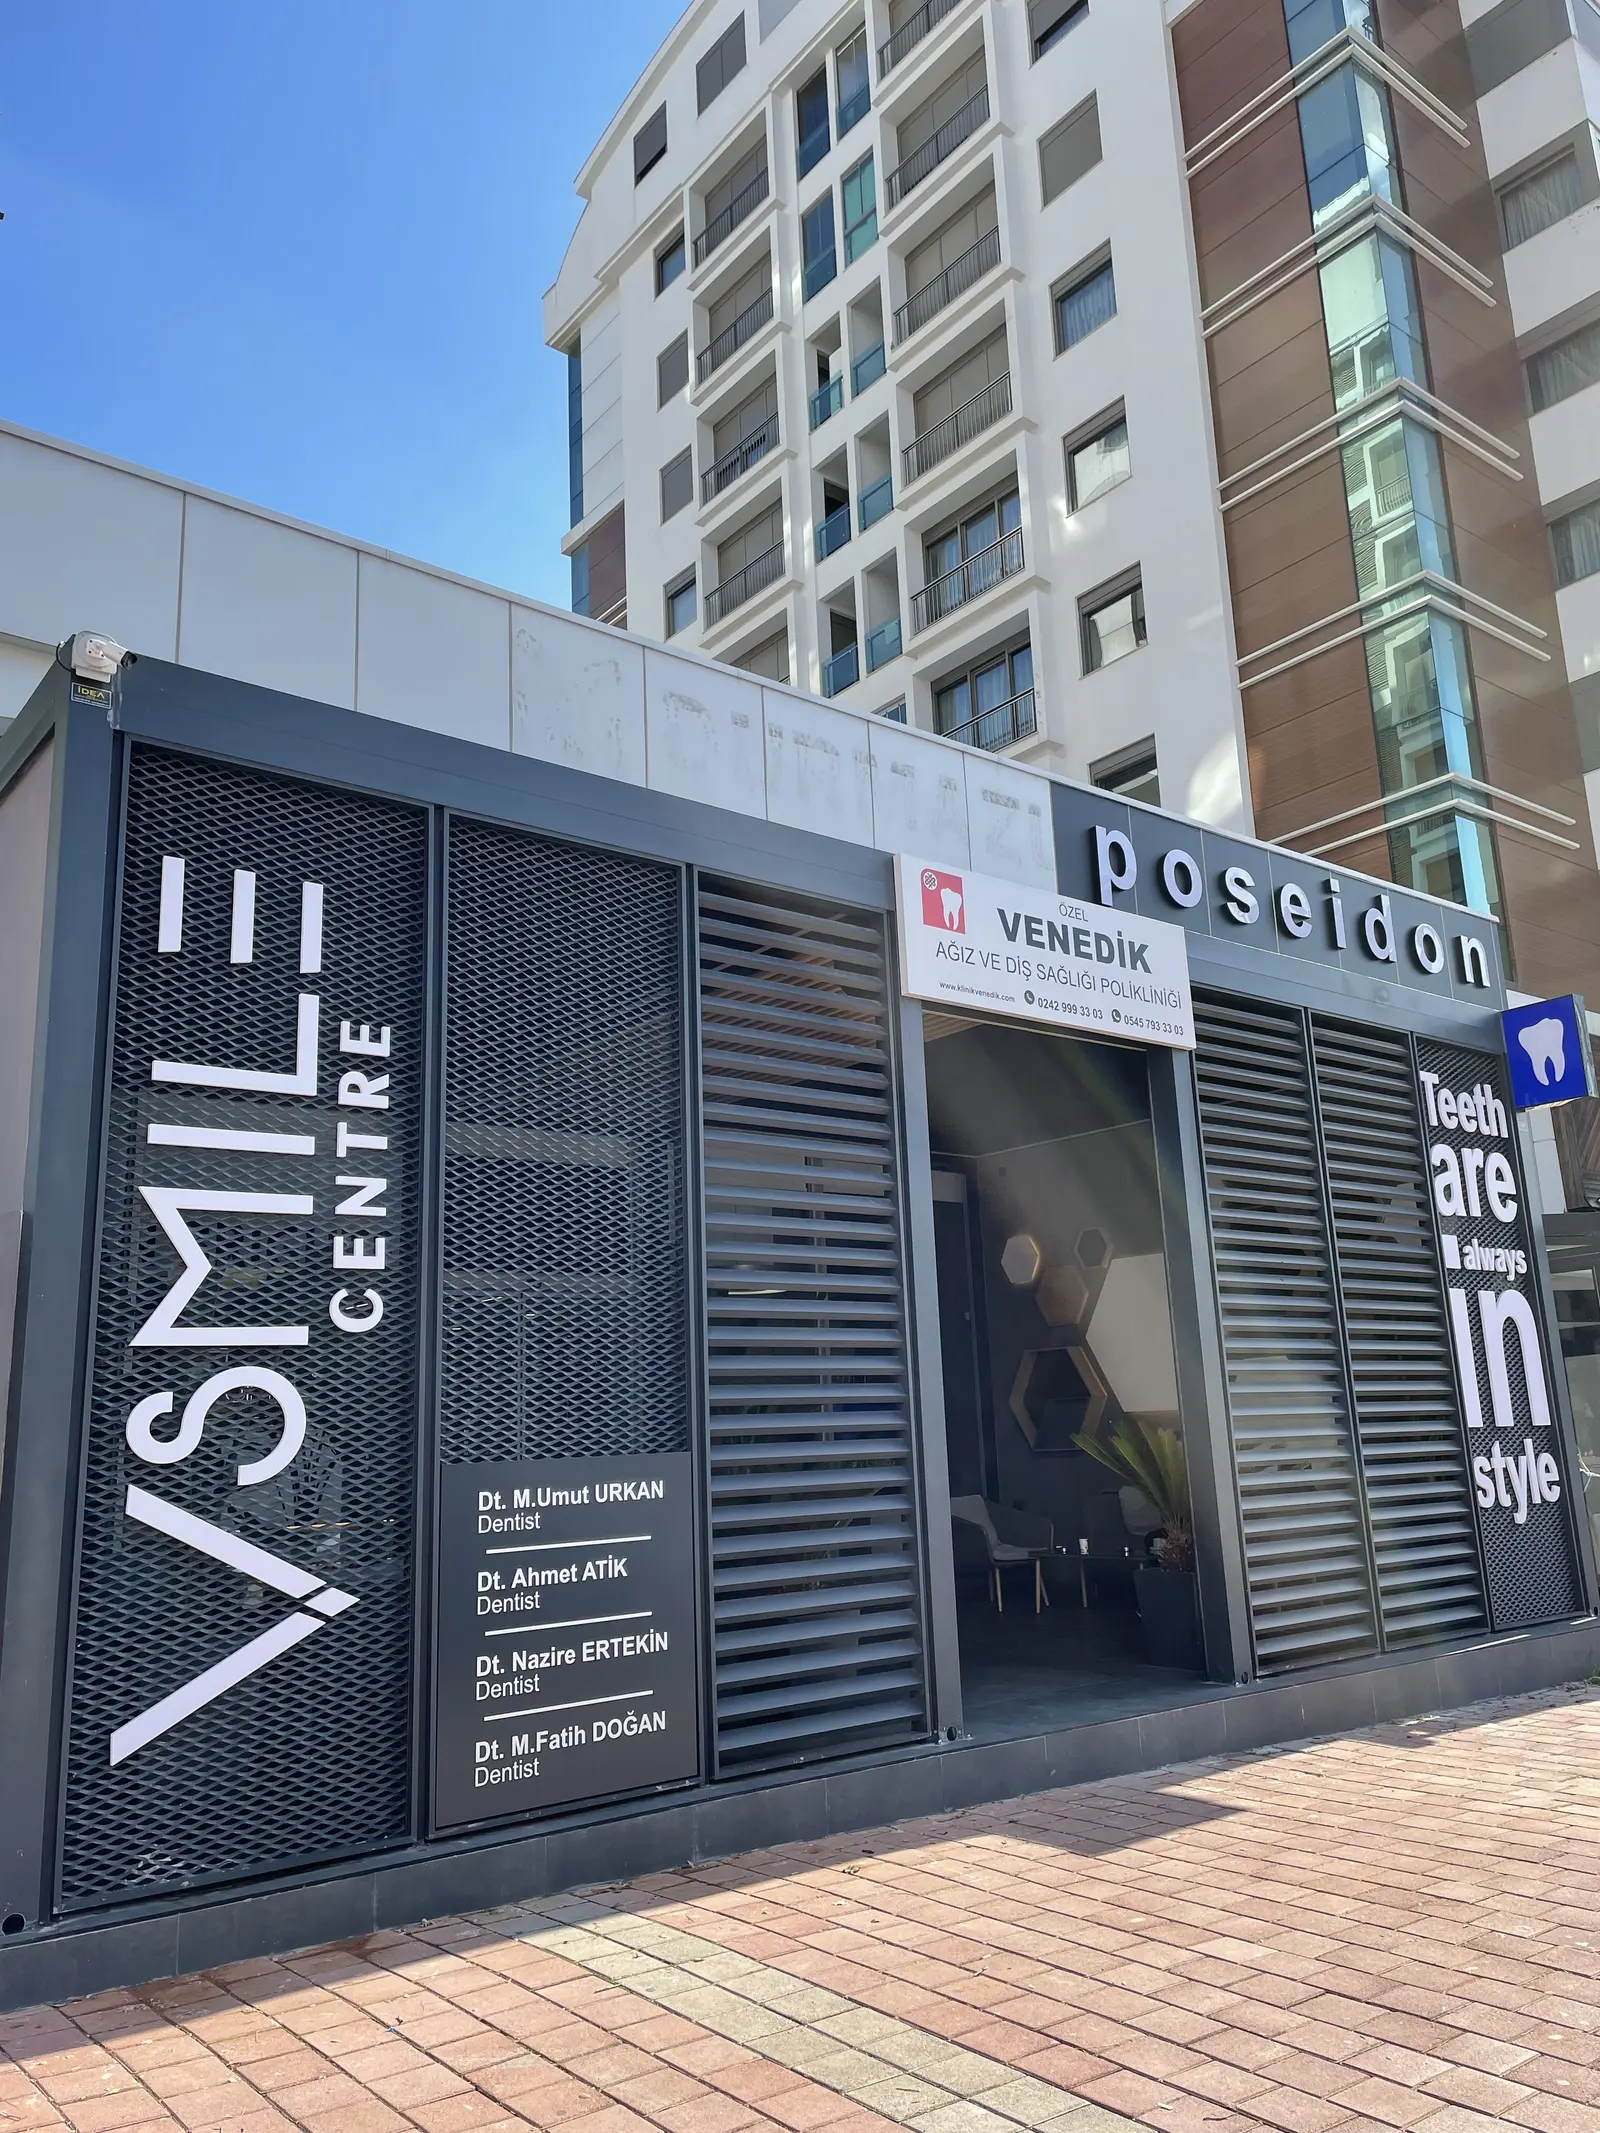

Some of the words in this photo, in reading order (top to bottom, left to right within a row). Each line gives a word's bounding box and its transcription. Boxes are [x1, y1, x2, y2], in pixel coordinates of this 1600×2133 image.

[1058, 901, 1089, 922] ÖZEL
[1095, 825, 1491, 988] poseidon
[996, 907, 1152, 974] VENEDİK
[935, 940, 976, 966] AĞIZ
[979, 950, 1001, 971] VE
[1006, 955, 1032, 982] DİŞ
[1036, 963, 1097, 993] SAĞLIĞI
[1100, 977, 1183, 1010] POLİKLİNİĞİ
[939, 981, 1016, 1003] www.klinikvenedik.com
[1037, 997, 1060, 1012] 0242
[1061, 1003, 1078, 1016] 999
[1079, 1006, 1091, 1018] 33
[1092, 1009, 1104, 1020] 03
[1123, 1014, 1145, 1029] 0545
[1145, 1019, 1162, 1032] 793
[1162, 1023, 1174, 1034] 33
[1174, 1025, 1185, 1036] 03
[1419, 1070, 1509, 1139] Teeth
[328, 1019, 392, 1334] CENTRE
[1431, 1142, 1518, 1224] are
[1462, 1237, 1529, 1282] always
[1442, 1234, 1552, 1428] in
[478, 1491, 507, 1511] Dt.
[513, 1485, 590, 1509] M.Umut
[595, 1480, 665, 1502] URKAN
[1473, 1437, 1562, 1525] style
[478, 1512, 541, 1534] Dentist
[477, 1571, 506, 1592] Dt.
[511, 1564, 578, 1589] Ahmet
[581, 1555, 628, 1582] ATİK
[476, 1591, 541, 1616] Dentist
[476, 1655, 505, 1678] Dt.
[512, 1646, 576, 1672] Nazire
[582, 1628, 668, 1662] ERTEKİN
[475, 1673, 540, 1701] Dentist
[475, 1739, 505, 1763] Dt.
[511, 1725, 586, 1757] M.Fatih
[592, 1710, 666, 1743] DOĞAN
[474, 1757, 540, 1788] Dentist
